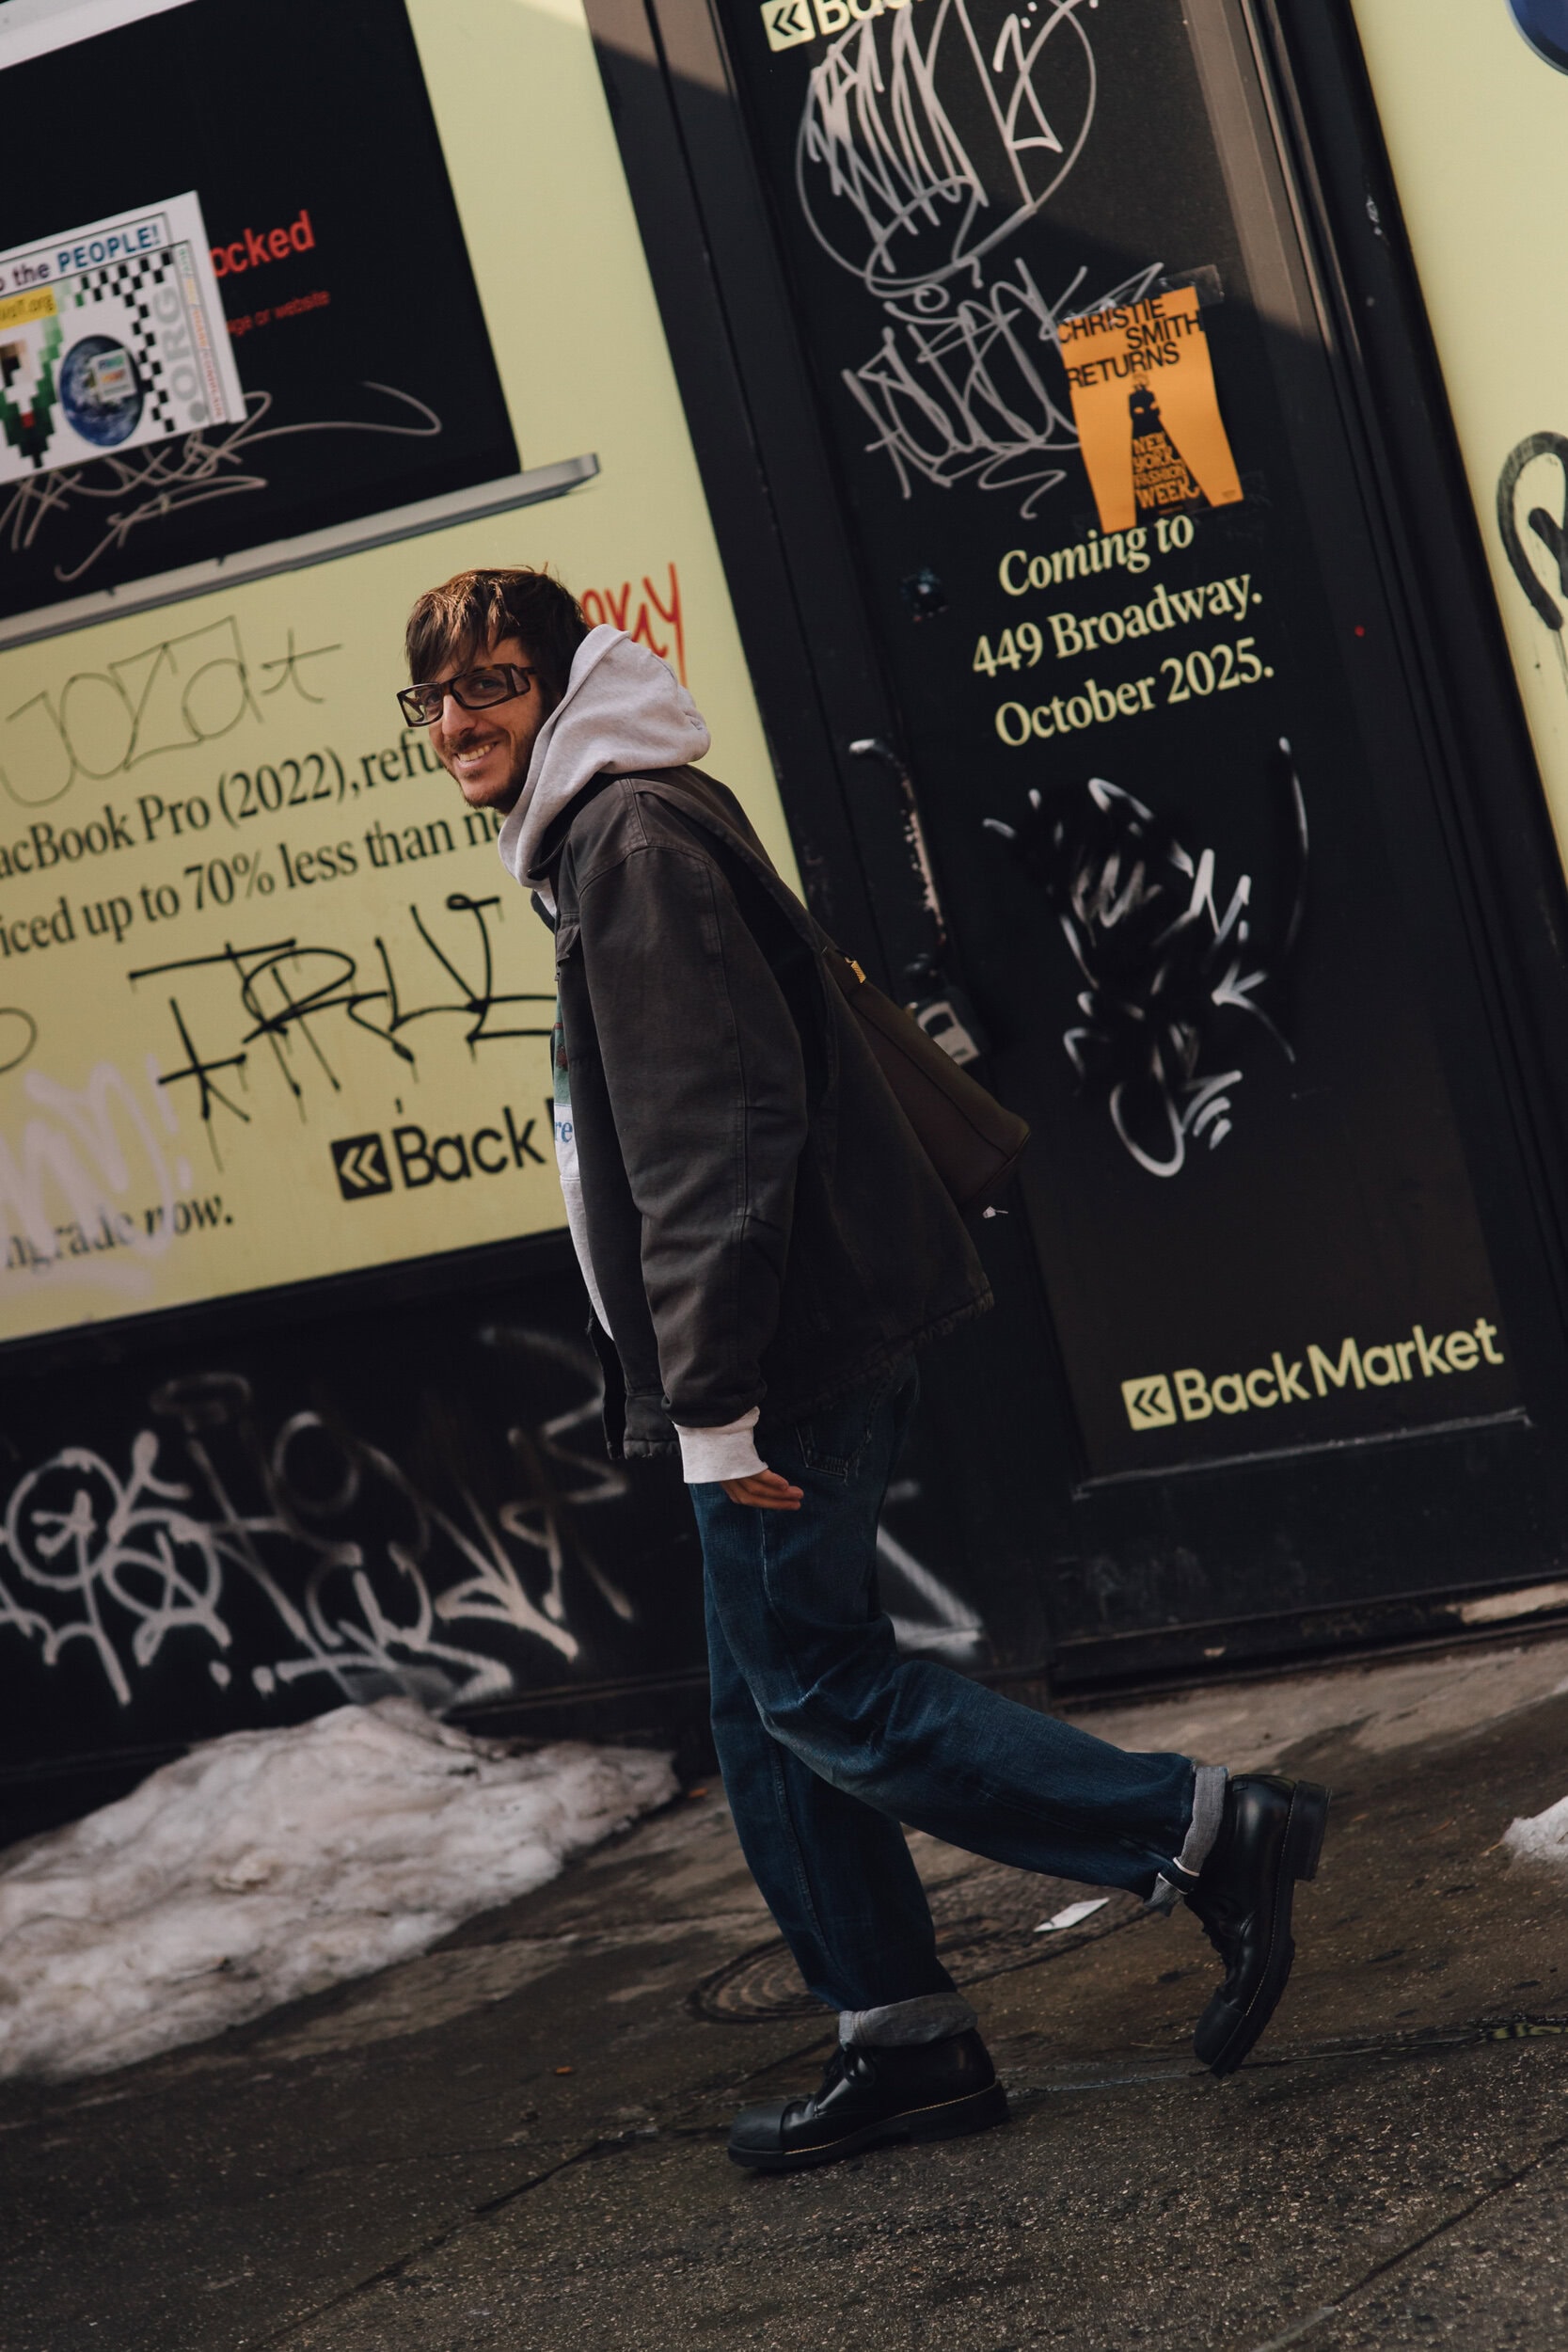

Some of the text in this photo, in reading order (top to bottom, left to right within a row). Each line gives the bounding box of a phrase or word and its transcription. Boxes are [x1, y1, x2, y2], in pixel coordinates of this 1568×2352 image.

[12, 262, 51, 287] the
[57, 224, 162, 273] PEOPLE!
[210, 208, 316, 278] ocked
[1057, 297, 1165, 344] CHRISTIE
[1126, 310, 1204, 351] SMITH
[1066, 342, 1180, 389] RETURNS
[1133, 446, 1182, 473] YORK
[1134, 472, 1200, 510] WEEK
[998, 514, 1195, 596] Coming to
[973, 573, 1263, 678] 449 Broadway.
[994, 636, 1275, 747] October 2025.
[137, 793, 211, 843] Pro
[216, 745, 361, 830] (2022),
[82, 896, 134, 944] up
[139, 882, 181, 922] to
[183, 849, 276, 911] 70%
[277, 841, 358, 889] less
[364, 820, 455, 869] than
[391, 1104, 546, 1189] Back
[1174, 1317, 1504, 1422] Back Market
